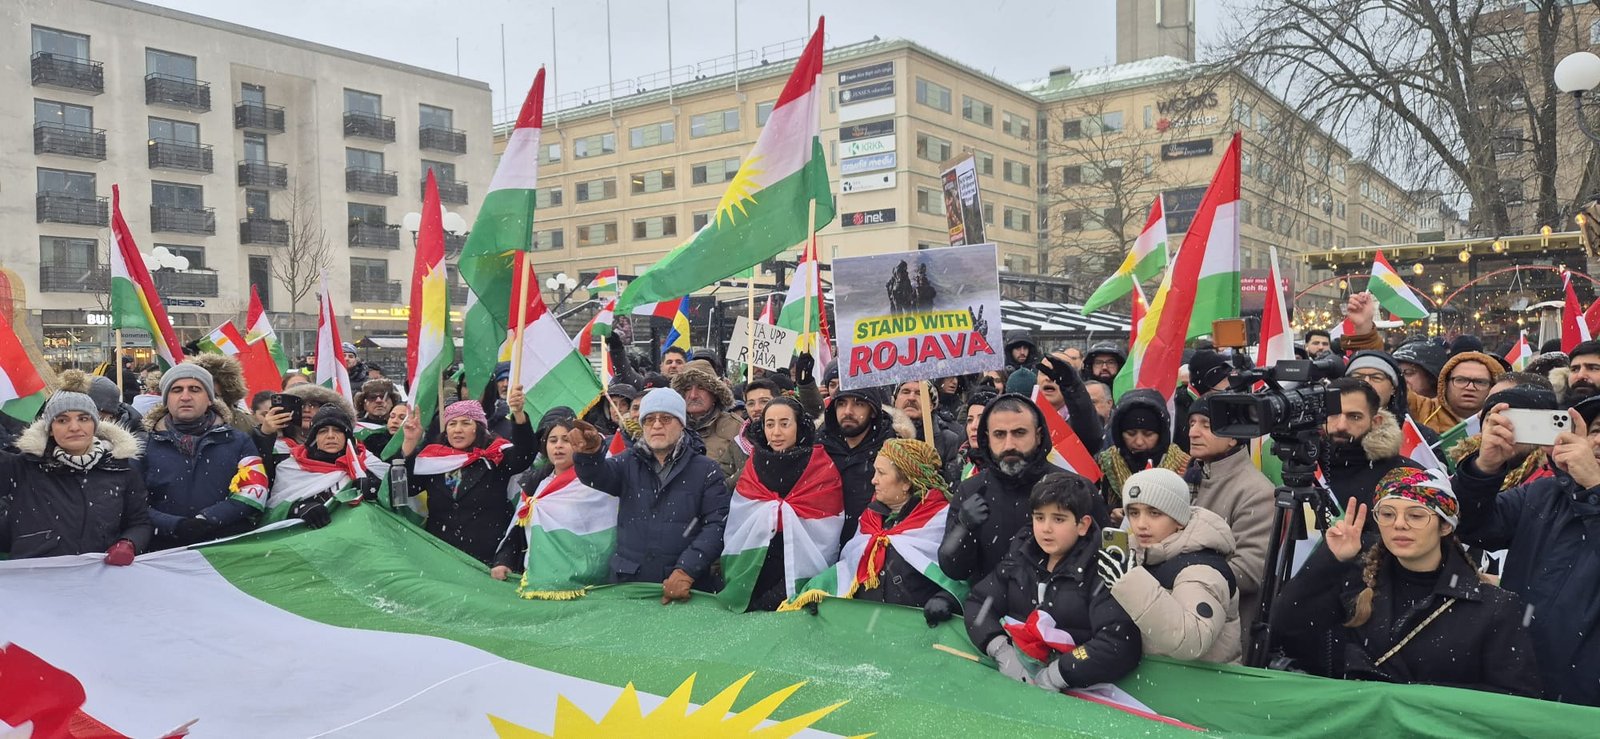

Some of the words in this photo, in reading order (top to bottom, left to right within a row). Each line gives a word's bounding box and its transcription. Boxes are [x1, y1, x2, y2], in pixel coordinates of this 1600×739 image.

[864, 211, 883, 224] inet
[770, 327, 786, 344] UPP
[856, 316, 916, 340] STAND
[921, 313, 968, 330] WITH
[848, 331, 995, 377] ROJAVA
